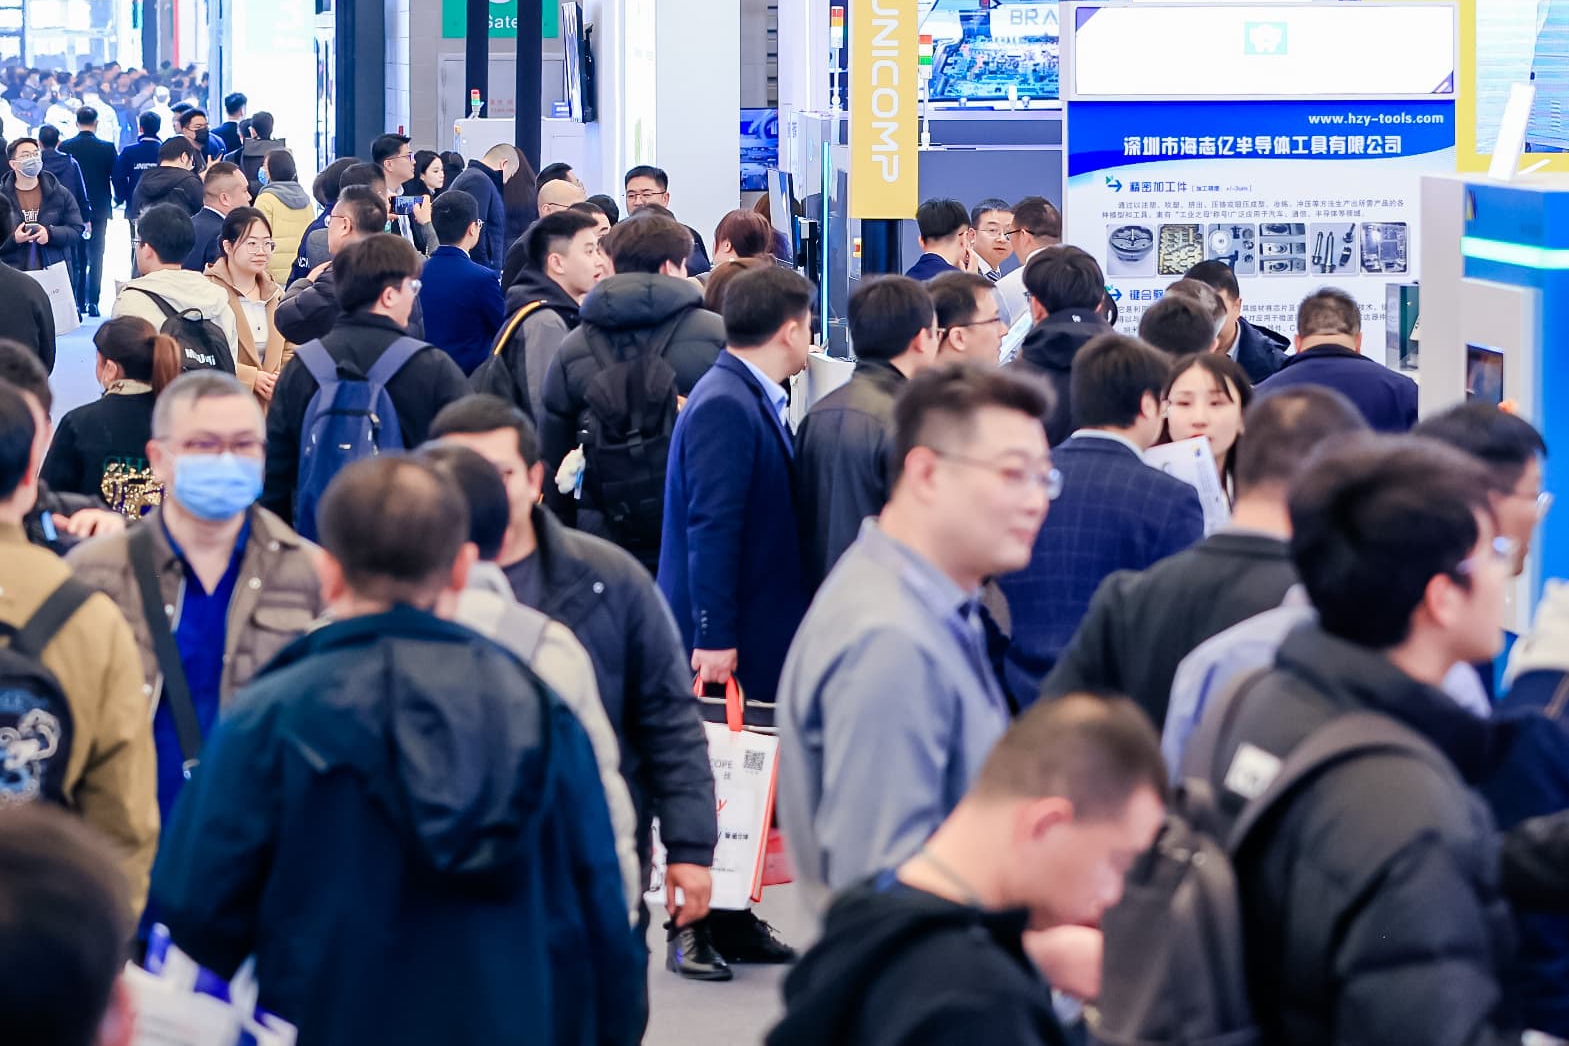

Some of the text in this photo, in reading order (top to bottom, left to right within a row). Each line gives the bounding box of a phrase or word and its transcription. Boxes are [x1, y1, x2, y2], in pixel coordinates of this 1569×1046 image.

[1308, 111, 1445, 125] www.hzy-tools.com
[1123, 135, 1402, 156] 深圳市海志亿半导体工具有限公司
